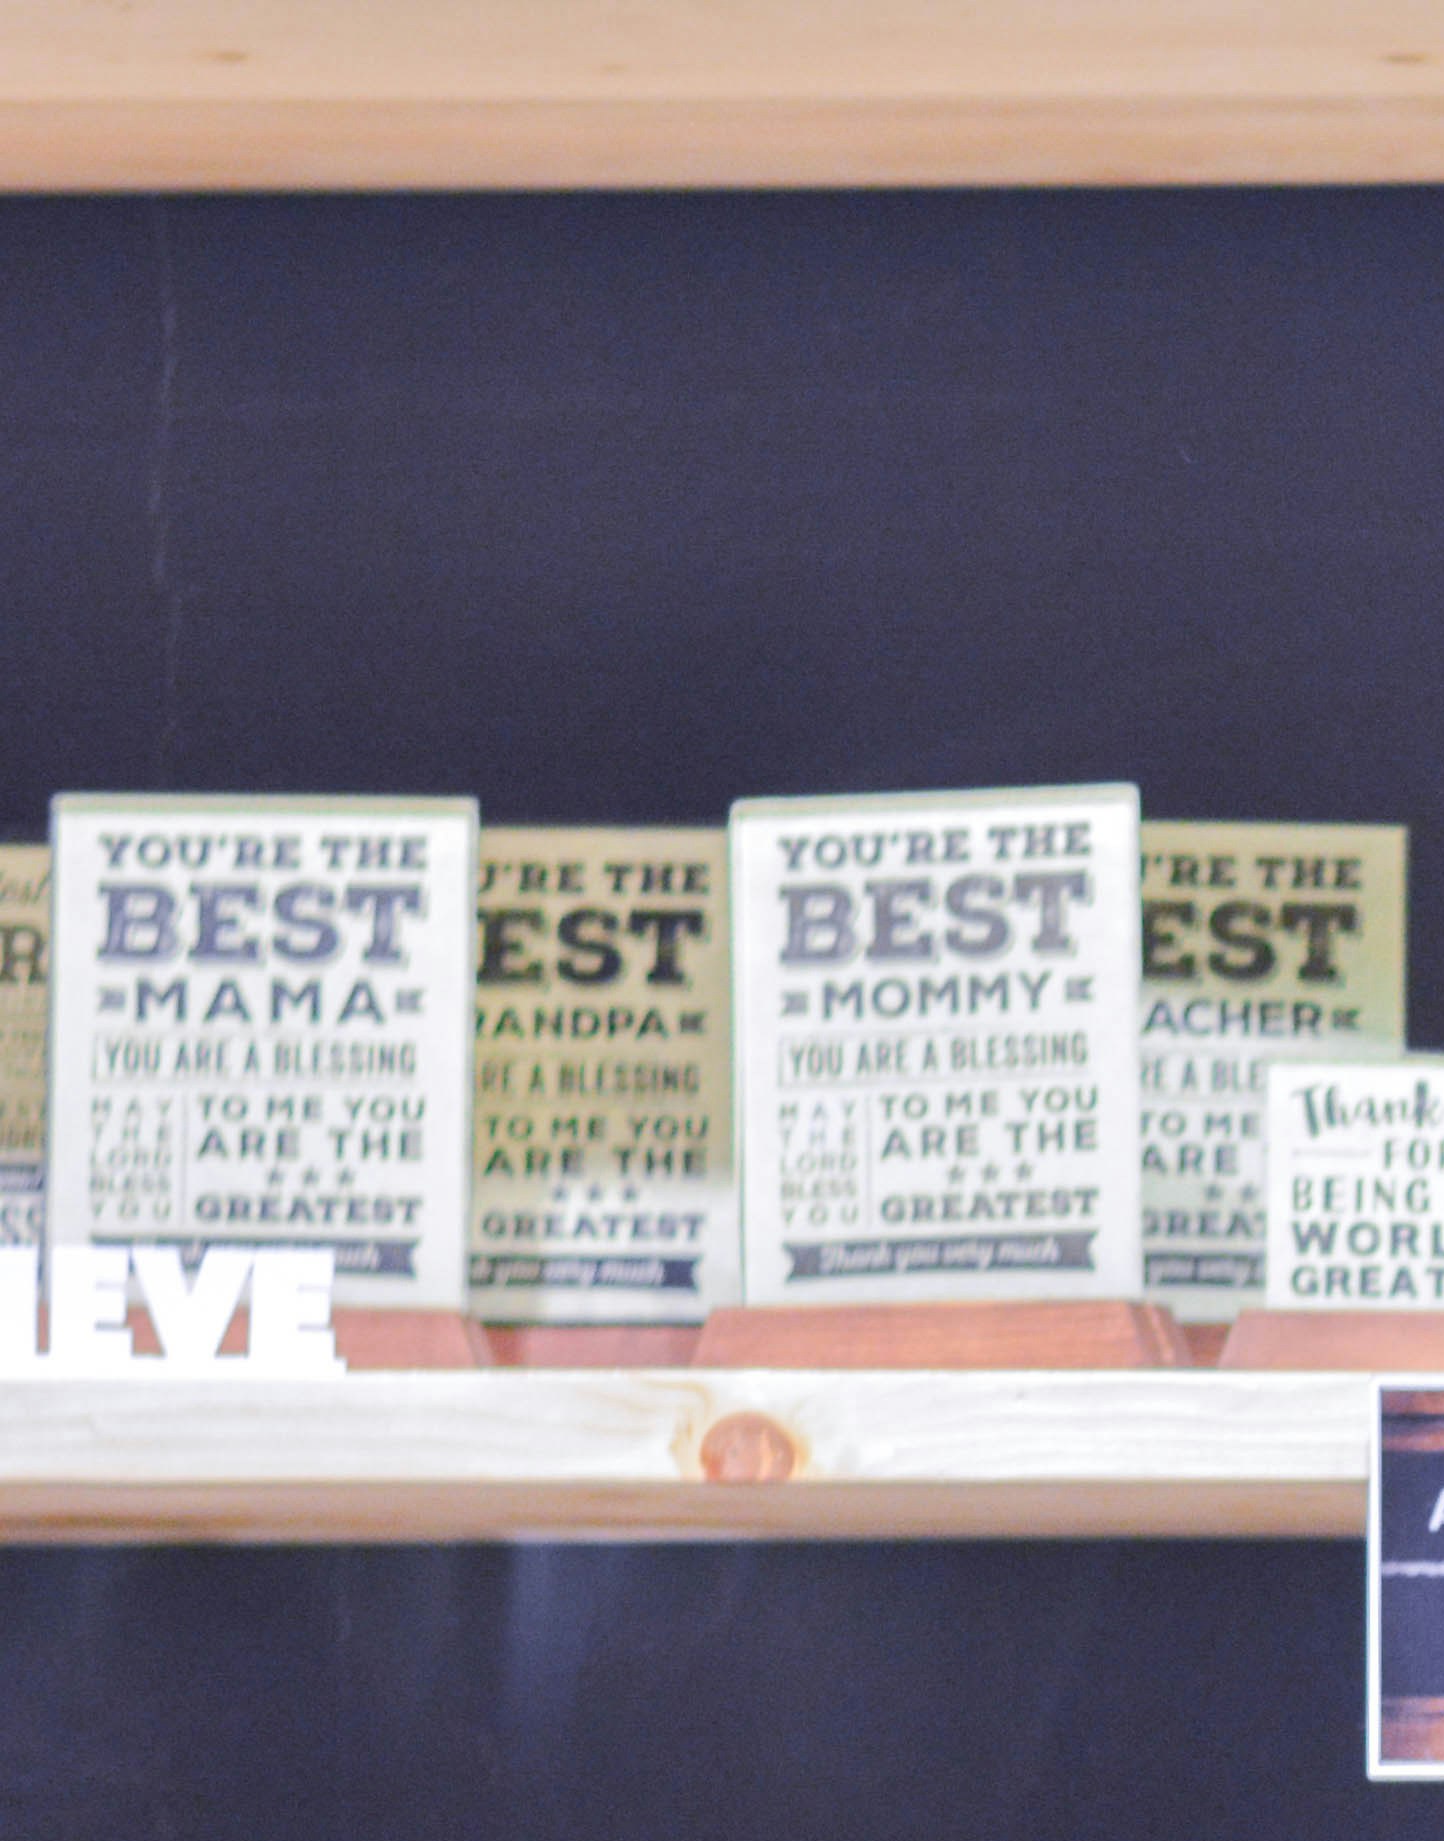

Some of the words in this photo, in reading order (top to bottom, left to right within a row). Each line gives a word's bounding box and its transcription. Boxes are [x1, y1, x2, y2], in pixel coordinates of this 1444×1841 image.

[98, 834, 300, 871] YOU'RE
[321, 835, 428, 871] THE
[778, 829, 971, 871] YOU'RE
[987, 822, 1092, 862] THE
[604, 862, 709, 895] THE
[1256, 858, 1362, 890] THE
[96, 881, 427, 966] BEST
[778, 869, 1090, 966] BEST
[476, 907, 703, 988] EST
[1142, 902, 1359, 984] EST
[136, 977, 386, 1025] MAMA
[822, 970, 1053, 1020] MOMMY
[1146, 1000, 1323, 1037] ACHER
[105, 1039, 160, 1076] YOU
[175, 1039, 231, 1076] ARE
[273, 1039, 418, 1078] BLESSING
[789, 1043, 846, 1078] YOU
[855, 1038, 911, 1074] ARE
[950, 1031, 1088, 1070] BLESSING
[559, 1060, 699, 1094] BLESSING
[201, 1095, 249, 1121] TO
[266, 1095, 324, 1121] ME
[343, 1095, 427, 1121] YOU
[880, 1092, 930, 1121] TO
[945, 1090, 999, 1117] ME
[1021, 1085, 1100, 1113] YOU
[1290, 1078, 1444, 1139] Thank
[196, 1129, 300, 1161] ARE
[328, 1129, 425, 1161] THE
[552, 1115, 609, 1139] ME
[629, 1115, 710, 1139] YOU
[881, 1122, 979, 1159] ARE
[1006, 1119, 1099, 1155] THE
[483, 1146, 584, 1177] ARE
[612, 1146, 708, 1177] THE
[780, 1179, 857, 1201] BLESS
[880, 1187, 1100, 1225] GREATEST
[1291, 1178, 1432, 1213] BEING
[194, 1195, 425, 1227] GREATEST
[481, 1213, 706, 1240] GREATEST
